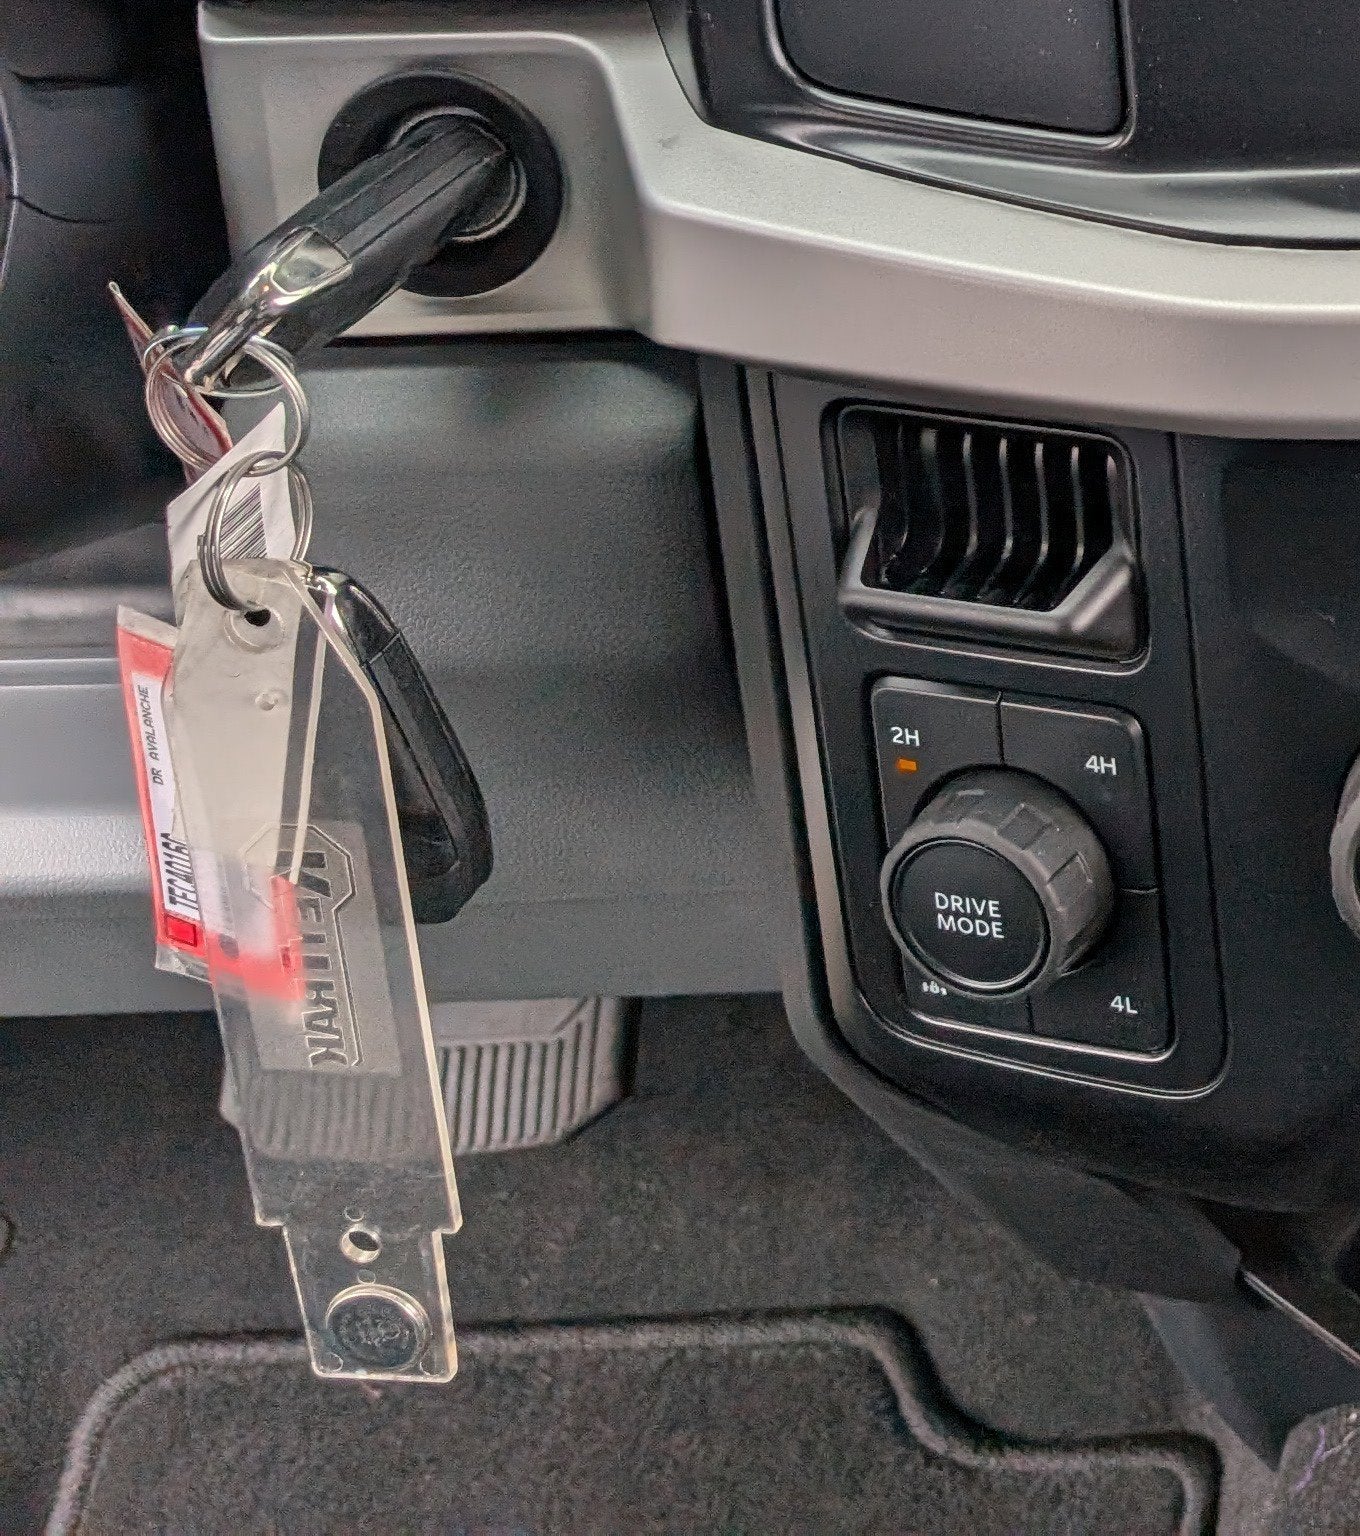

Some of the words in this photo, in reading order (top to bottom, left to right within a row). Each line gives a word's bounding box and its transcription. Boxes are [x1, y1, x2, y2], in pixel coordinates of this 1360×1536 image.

[138, 685, 159, 761] AVALANCHE
[890, 726, 920, 747] 2H
[1085, 755, 1118, 776] 4H
[151, 768, 164, 785] DR
[934, 891, 1002, 918] DRIVE
[937, 913, 1005, 940] MODE
[1110, 995, 1138, 1015] 4L
